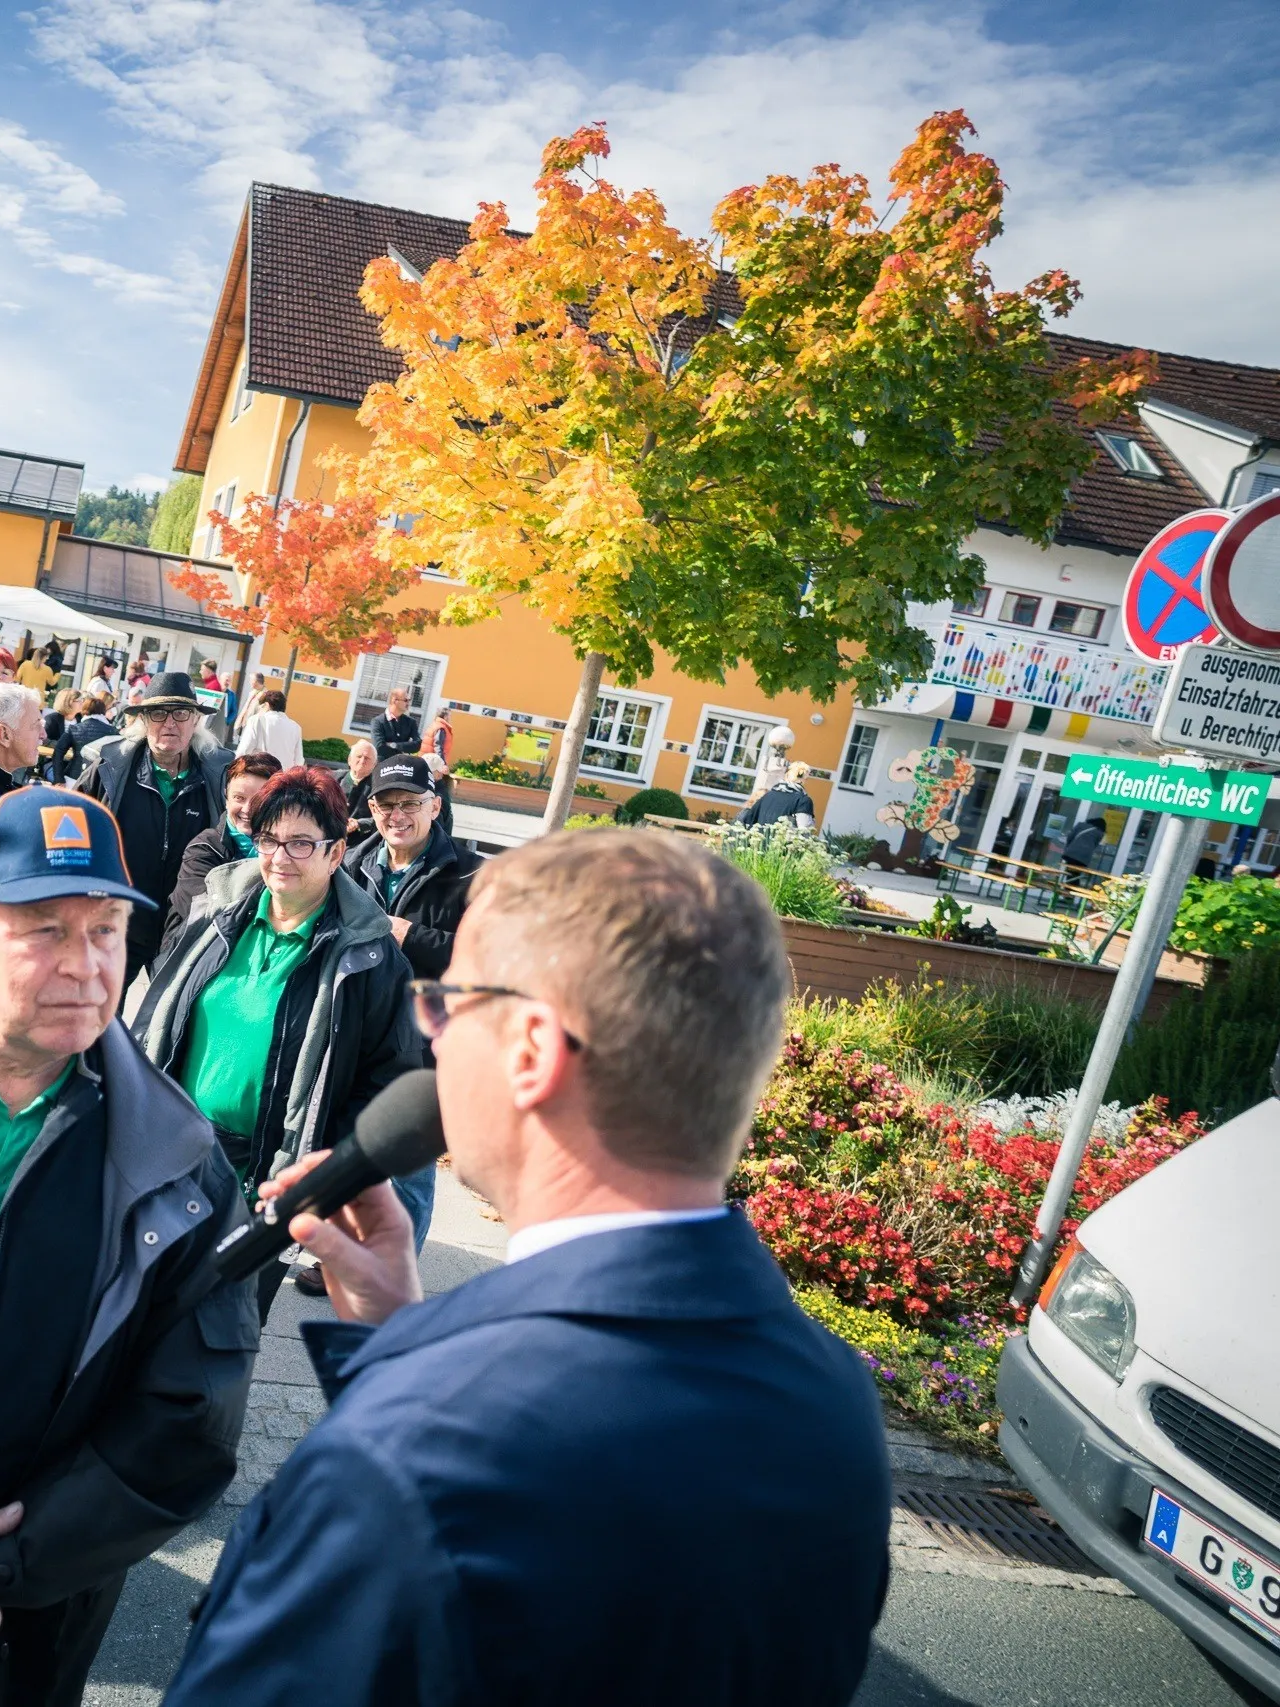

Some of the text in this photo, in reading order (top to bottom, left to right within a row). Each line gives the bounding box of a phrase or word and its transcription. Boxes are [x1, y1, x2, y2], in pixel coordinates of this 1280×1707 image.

[1201, 654, 1280, 686] ausgenom
[1180, 717, 1193, 737] u.
[1093, 764, 1260, 815] Öffentliches WC
[1157, 1530, 1167, 1543] A
[1200, 1535, 1224, 1575] G
